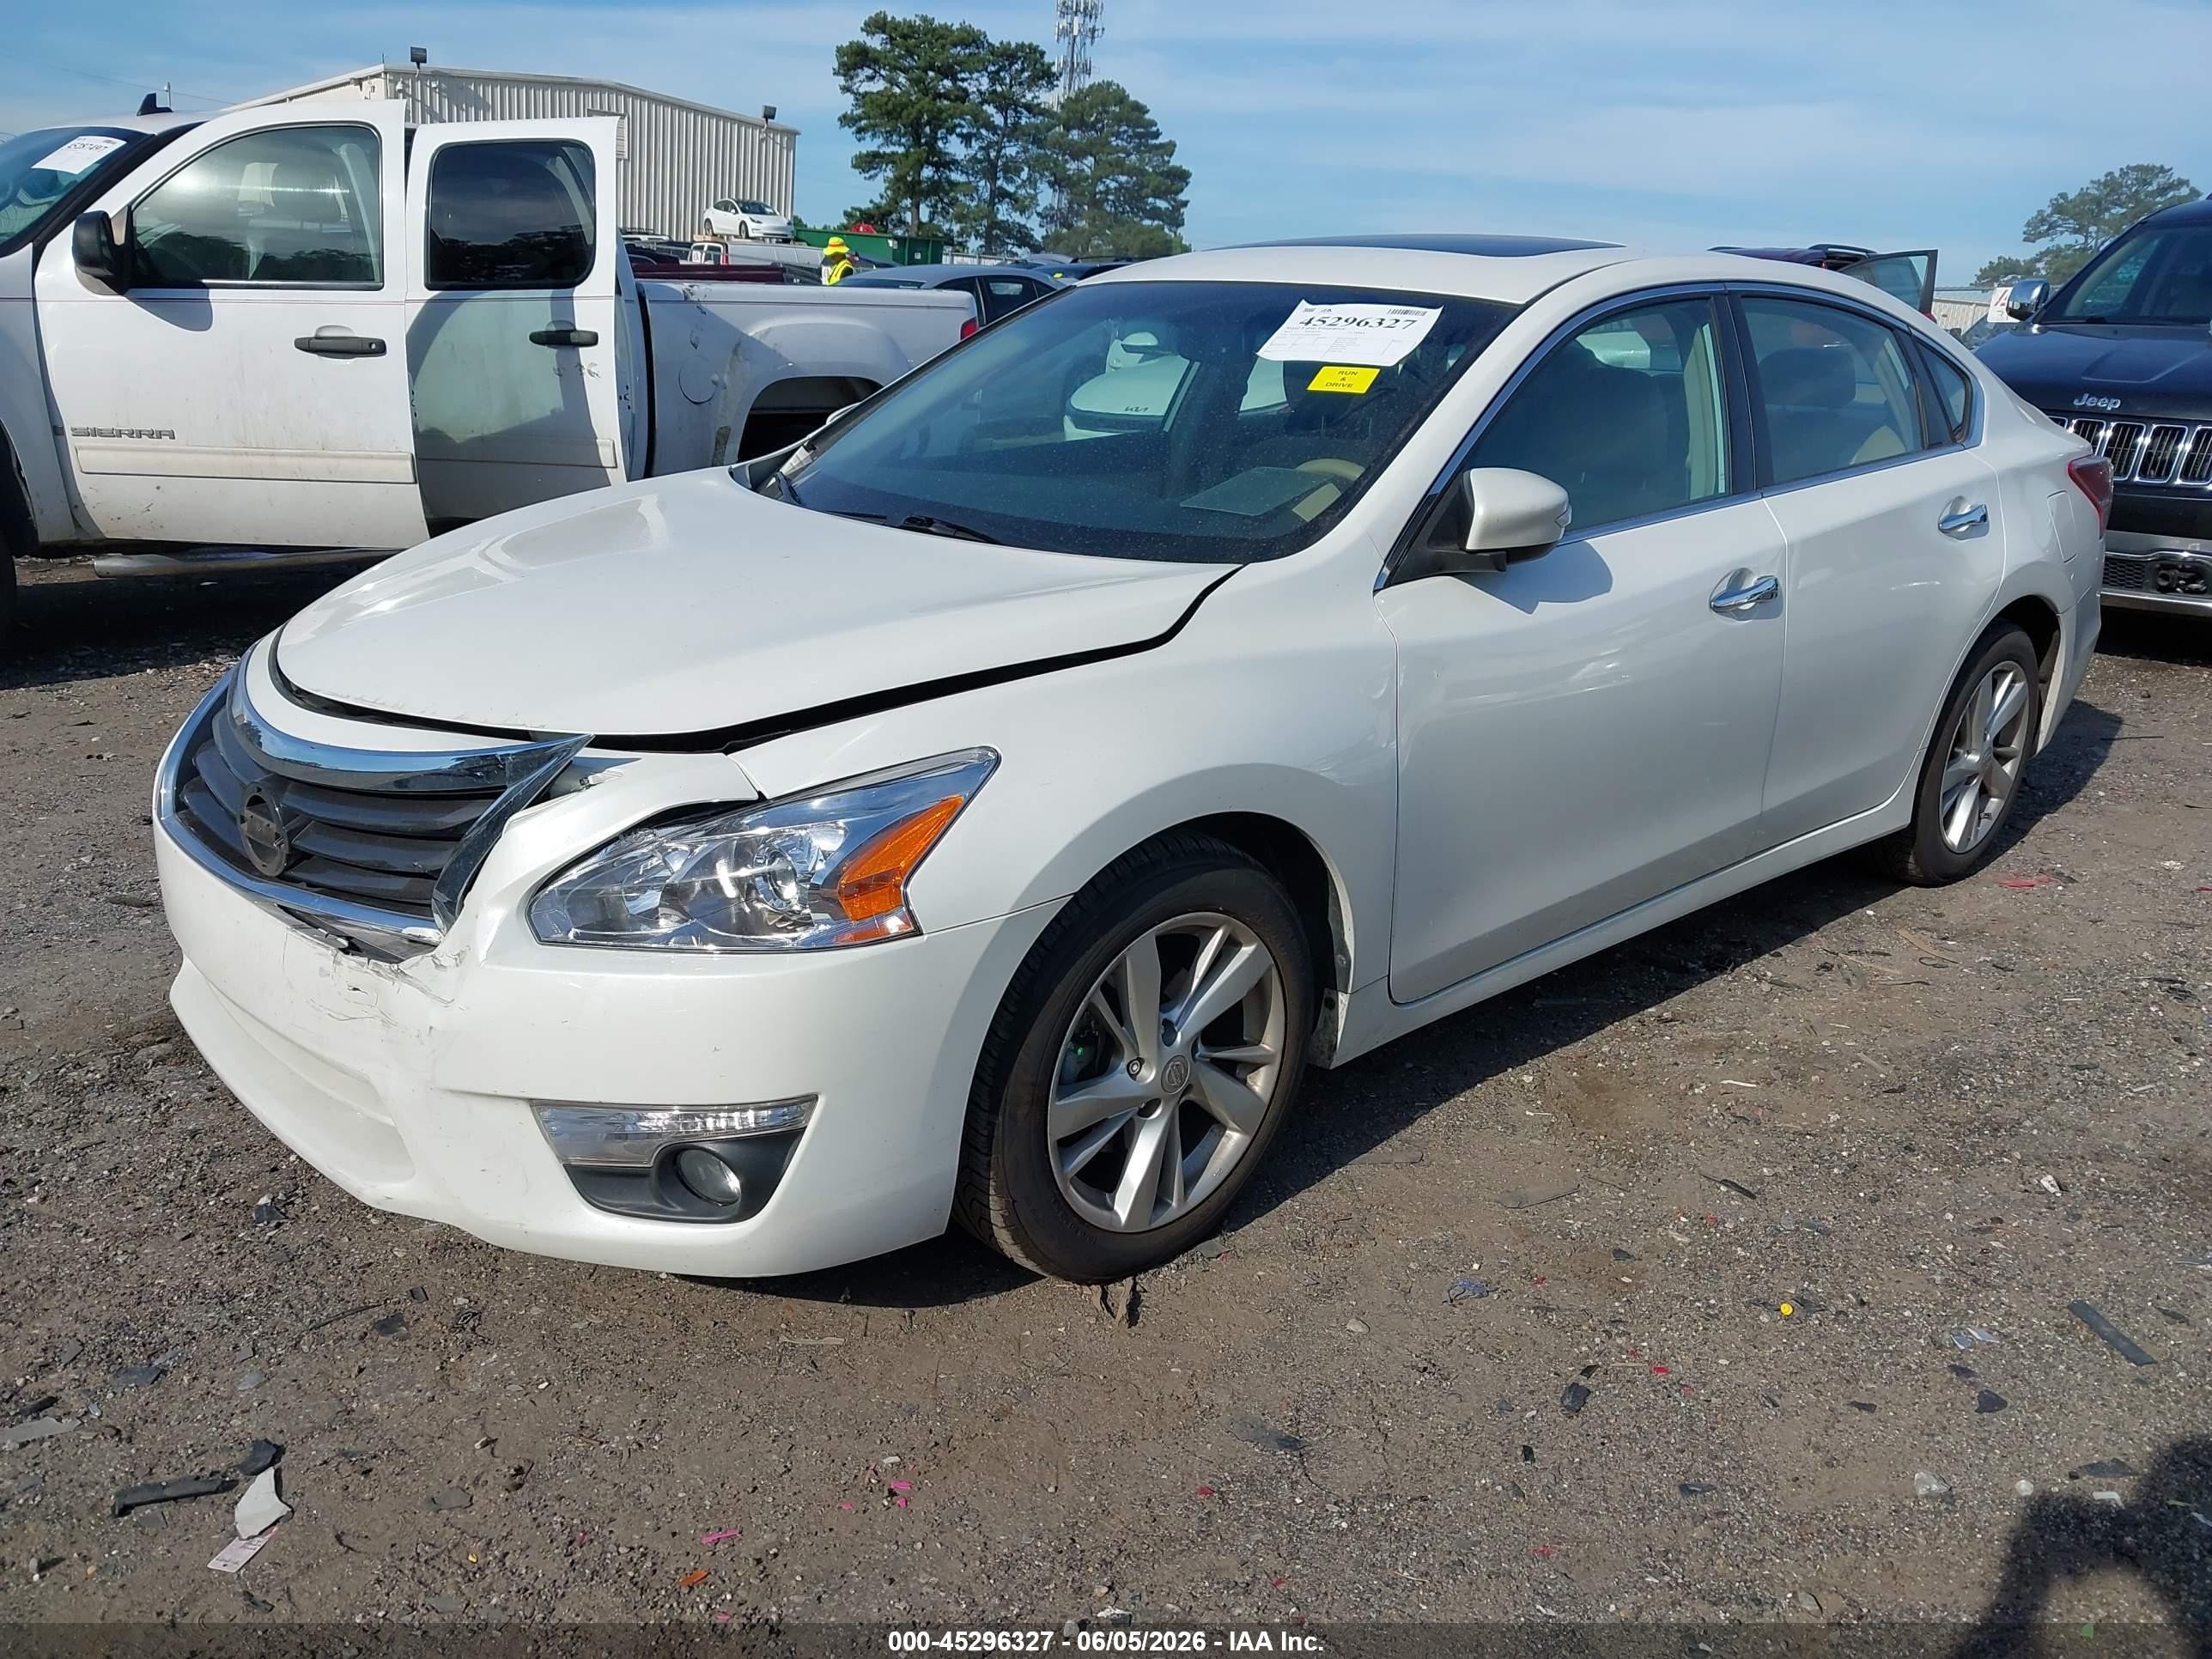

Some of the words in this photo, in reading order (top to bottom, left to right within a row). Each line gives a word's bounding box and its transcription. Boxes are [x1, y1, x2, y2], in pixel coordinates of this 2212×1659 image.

[1299, 316, 1418, 330] 45296327
[2073, 392, 2121, 410] Jeep
[70, 426, 176, 441] SIERRA
